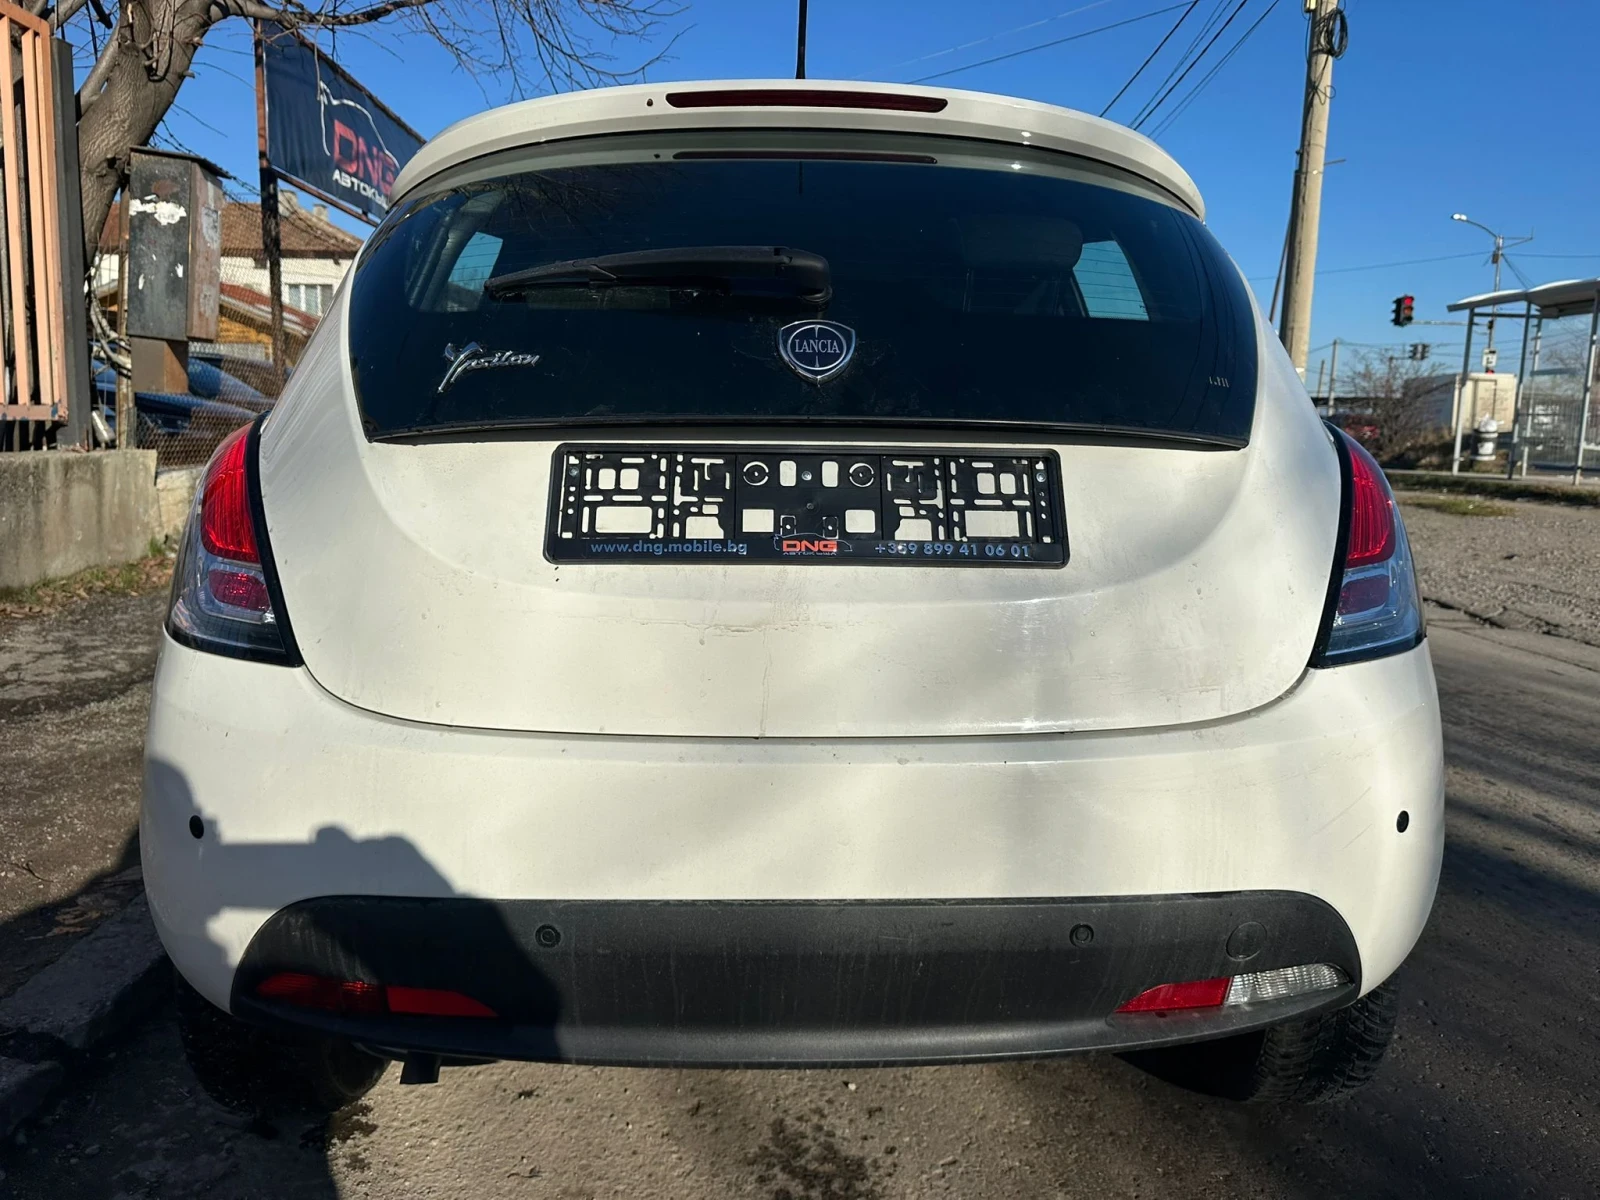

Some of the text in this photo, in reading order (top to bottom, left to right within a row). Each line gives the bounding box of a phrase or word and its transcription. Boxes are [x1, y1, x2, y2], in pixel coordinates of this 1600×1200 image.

[333, 119, 395, 196] DNG
[794, 338, 841, 353] LANCIA
[436, 341, 540, 393] Ypsilon
[590, 539, 748, 556] www.dng.mobile.bg
[782, 540, 838, 552] DNG
[923, 542, 954, 555] 899
[959, 543, 978, 556] 41
[984, 543, 1006, 557] 06
[1010, 544, 1030, 558] 01
